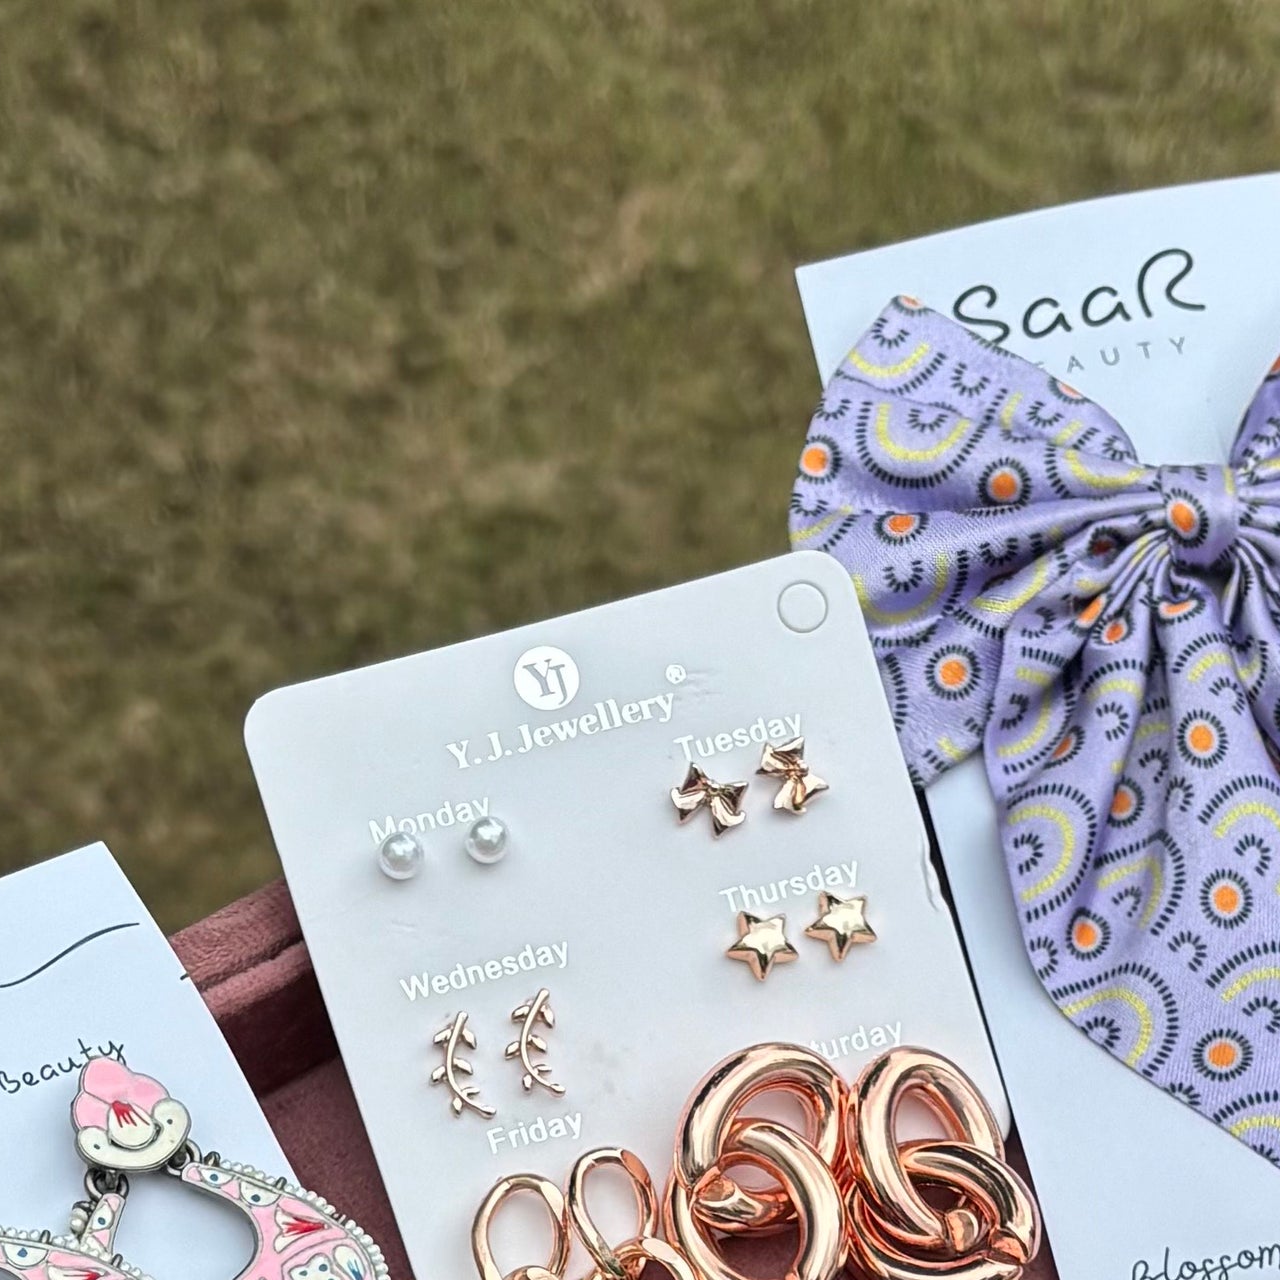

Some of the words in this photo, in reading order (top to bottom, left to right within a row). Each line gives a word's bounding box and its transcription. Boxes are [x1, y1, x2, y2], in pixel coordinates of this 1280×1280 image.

[952, 247, 1206, 346] SaaR
[1034, 336, 1186, 374] AUTY
[673, 712, 803, 762] Tuesday
[718, 859, 859, 913] Thursday
[399, 940, 569, 1002] Wednesday
[486, 1111, 584, 1156] Friday
